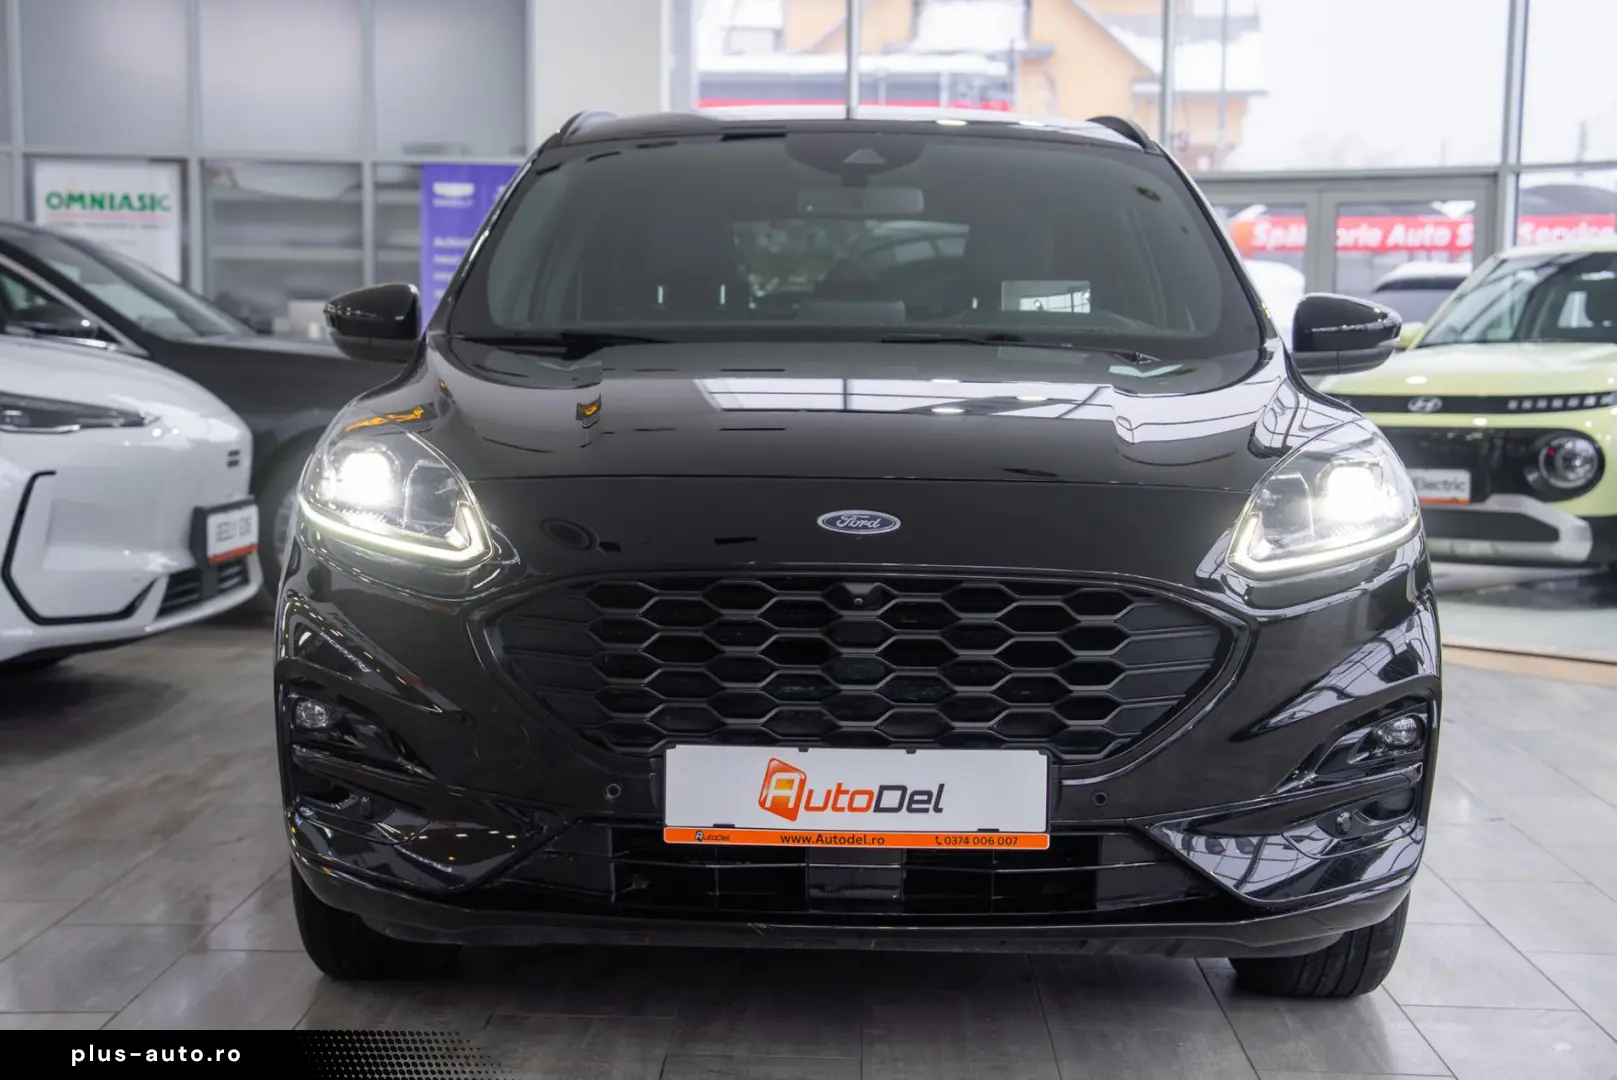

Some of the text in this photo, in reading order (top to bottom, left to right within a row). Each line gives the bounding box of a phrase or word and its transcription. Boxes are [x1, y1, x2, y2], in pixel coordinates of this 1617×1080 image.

[1386, 222, 1451, 247] Auto
[836, 514, 882, 528] Ford
[760, 764, 946, 815] AutoDel
[780, 833, 886, 846] www.Autodel.ro
[943, 835, 1019, 846] 0374 006 007
